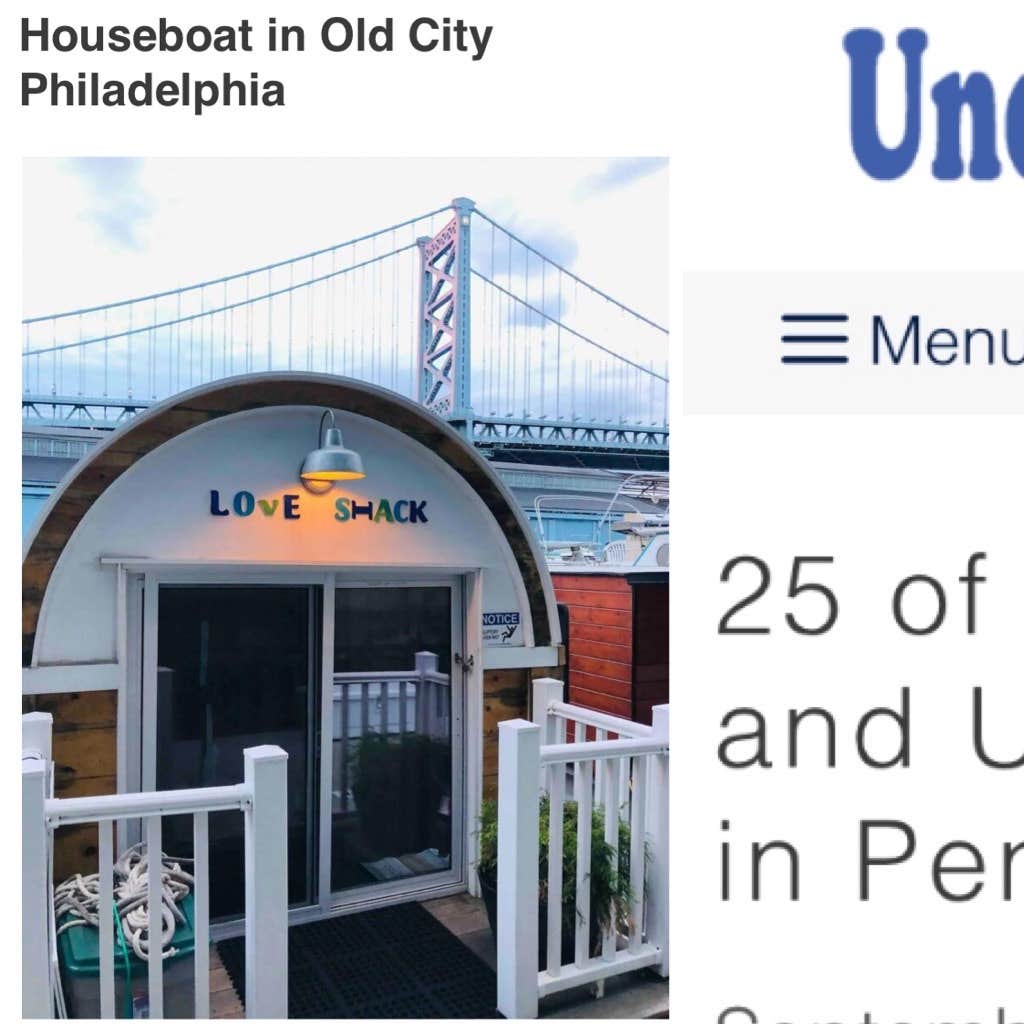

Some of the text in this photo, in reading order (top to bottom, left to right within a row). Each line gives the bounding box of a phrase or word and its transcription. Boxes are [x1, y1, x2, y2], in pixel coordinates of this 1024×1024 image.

[21, 16, 494, 62] Houseboat in Old City
[21, 71, 286, 116] Philadelphia
[334, 497, 429, 524] SHACK
[717, 555, 839, 636] 25
[892, 551, 987, 636] of
[717, 686, 911, 769] and
[721, 819, 800, 902] in
